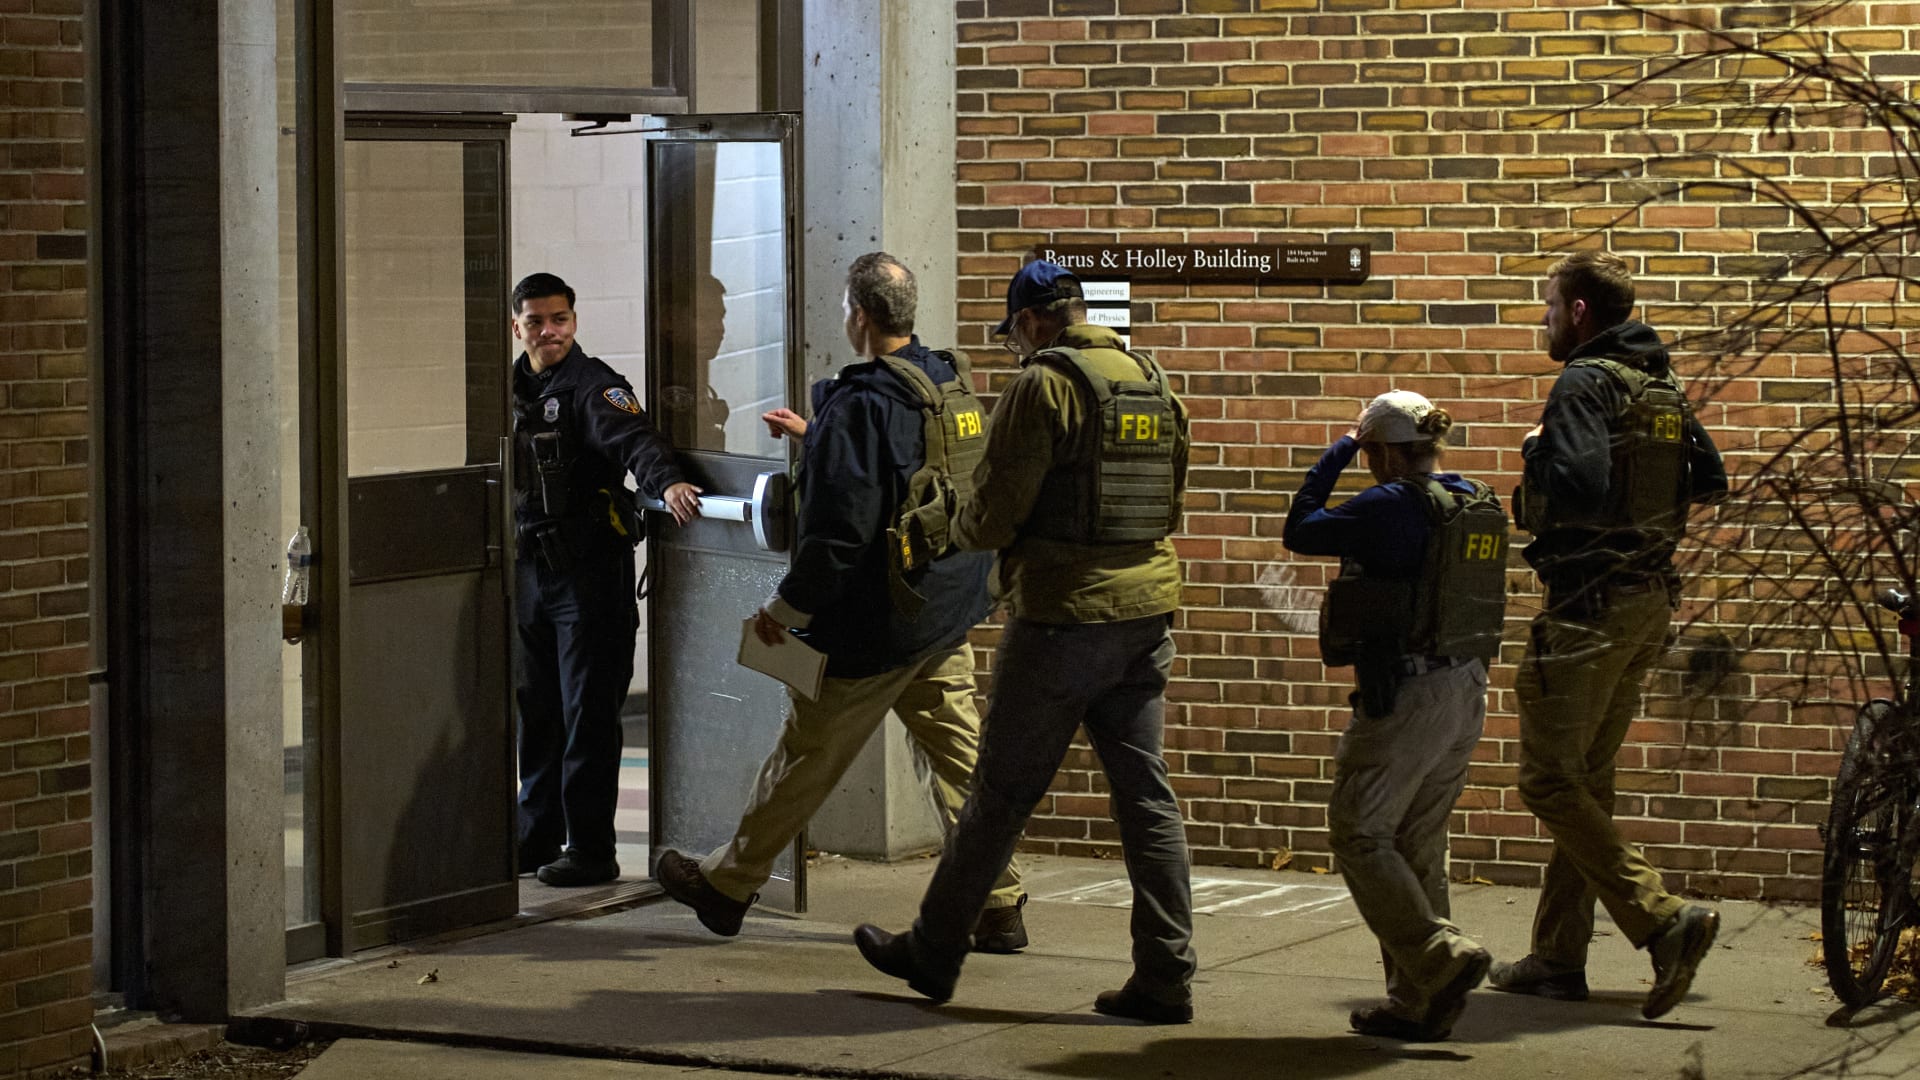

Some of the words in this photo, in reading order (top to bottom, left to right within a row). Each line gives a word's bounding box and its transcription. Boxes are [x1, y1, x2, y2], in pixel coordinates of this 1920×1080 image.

[1044, 249, 1095, 268] Barus
[1100, 249, 1119, 268] &
[1125, 248, 1187, 273] Holley
[1193, 248, 1271, 273] Building
[1084, 287, 1125, 297] ngineering
[1088, 312, 1096, 321] of
[1098, 312, 1126, 323] Physics
[956, 411, 982, 437] FBI
[1120, 414, 1160, 440] FBI
[1655, 414, 1682, 439] FBI
[902, 535, 911, 566] FBI
[1466, 533, 1500, 560] FBI
